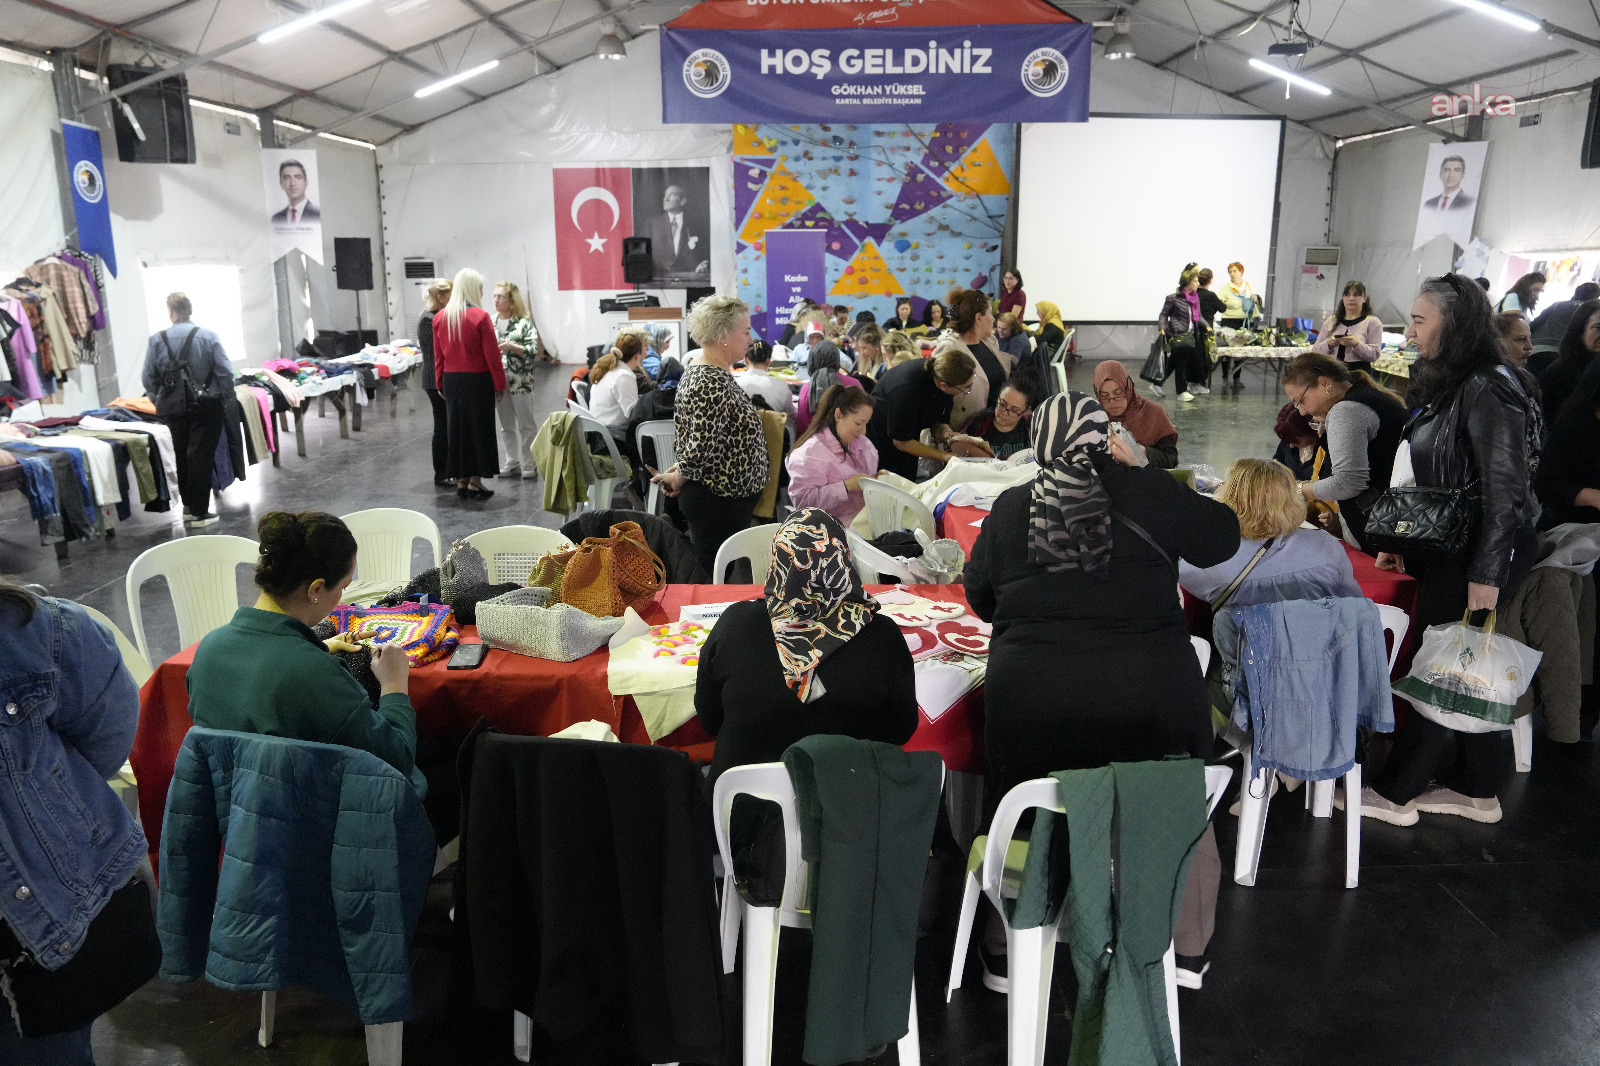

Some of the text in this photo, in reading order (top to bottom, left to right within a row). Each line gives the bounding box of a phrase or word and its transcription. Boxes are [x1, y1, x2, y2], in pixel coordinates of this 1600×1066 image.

[760, 40, 993, 79] HOŞ GELDİNİZ
[831, 83, 926, 95] GÖKHAN YÜKSEL
[862, 96, 893, 105] BELEDİYE
[893, 97, 922, 106] BAŞKANI
[784, 274, 808, 282] Kadın
